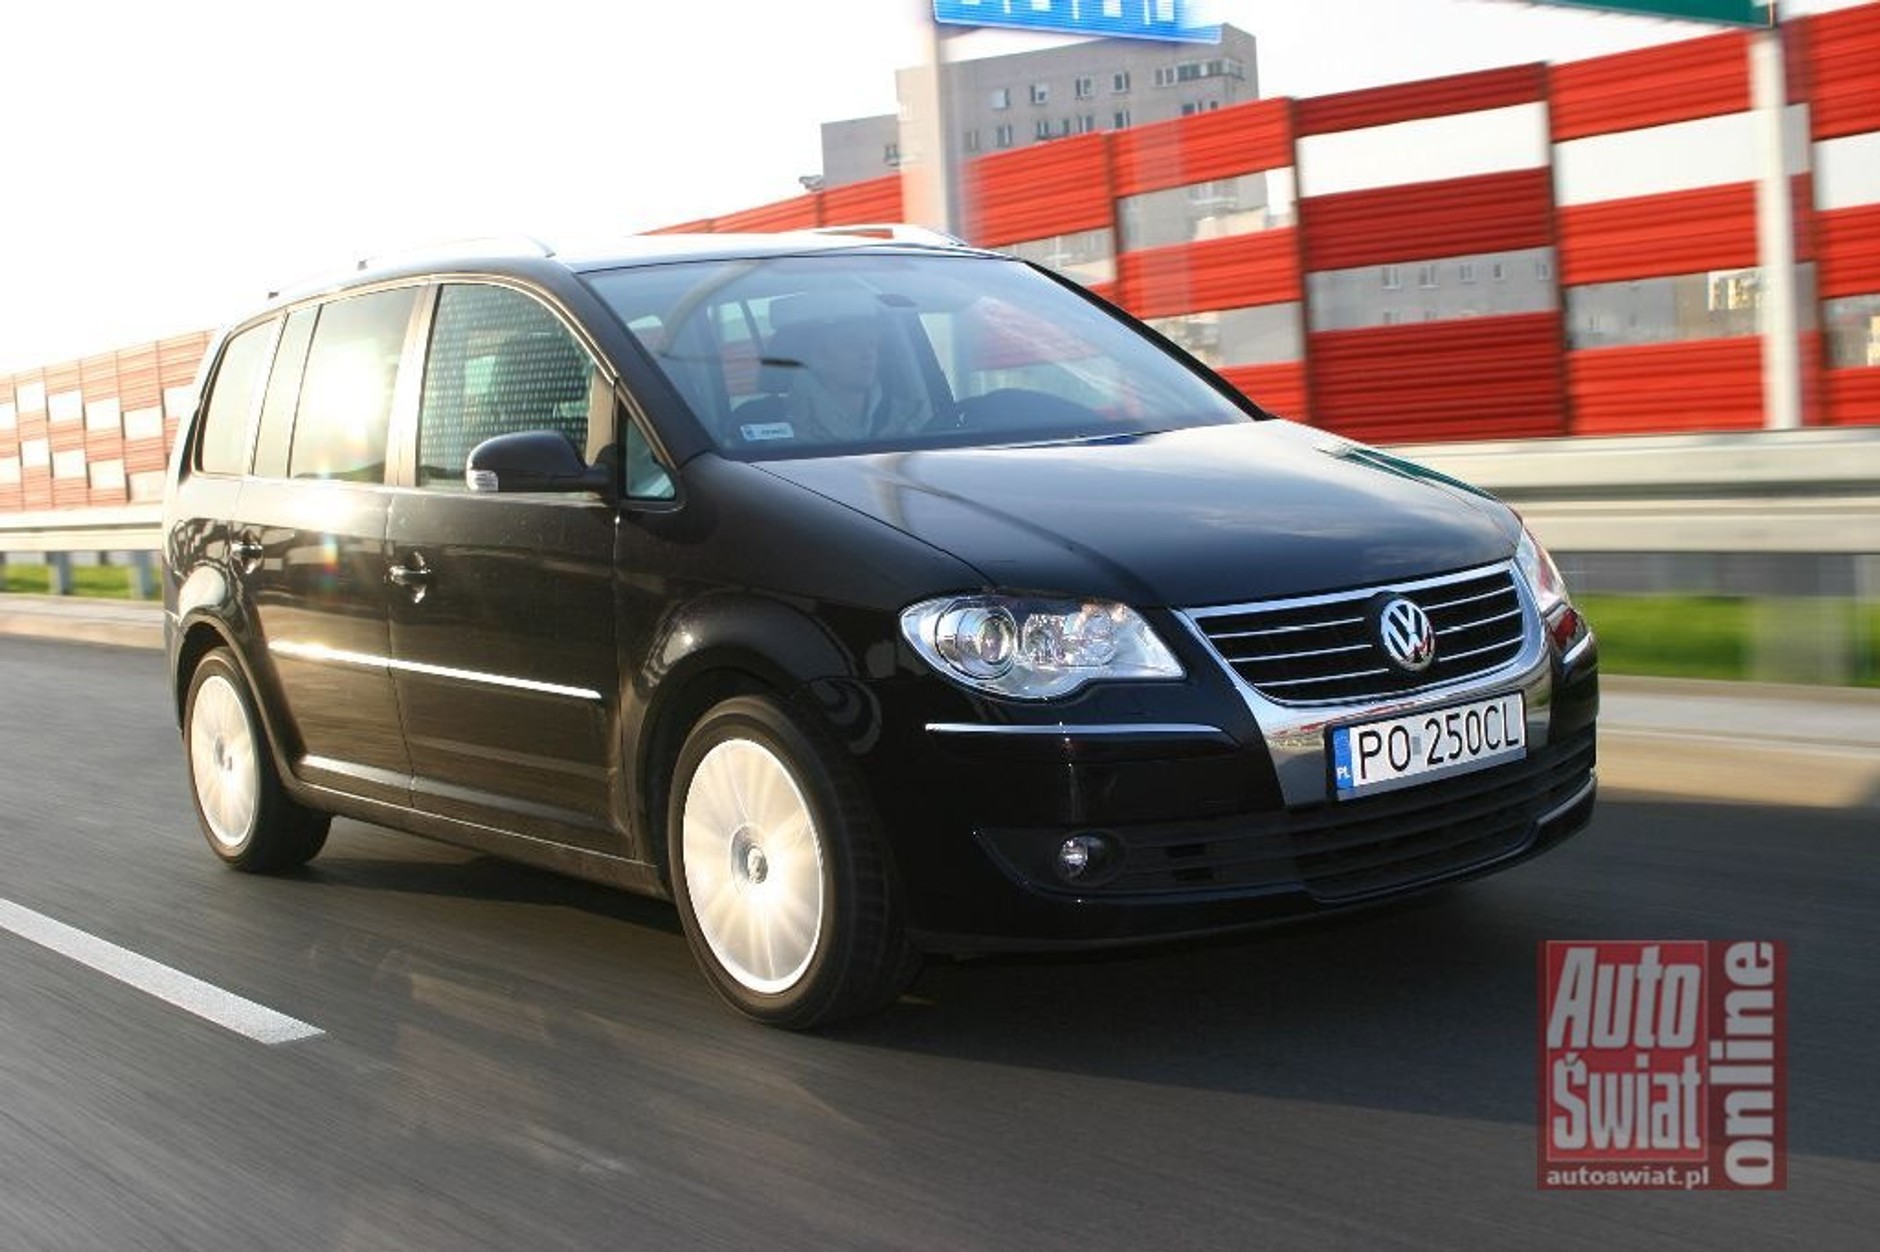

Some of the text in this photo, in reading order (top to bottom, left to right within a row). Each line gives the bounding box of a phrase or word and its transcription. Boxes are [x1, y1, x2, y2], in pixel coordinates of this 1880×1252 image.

[1358, 701, 1519, 780] PO 250CL
[1336, 766, 1351, 779] PL
